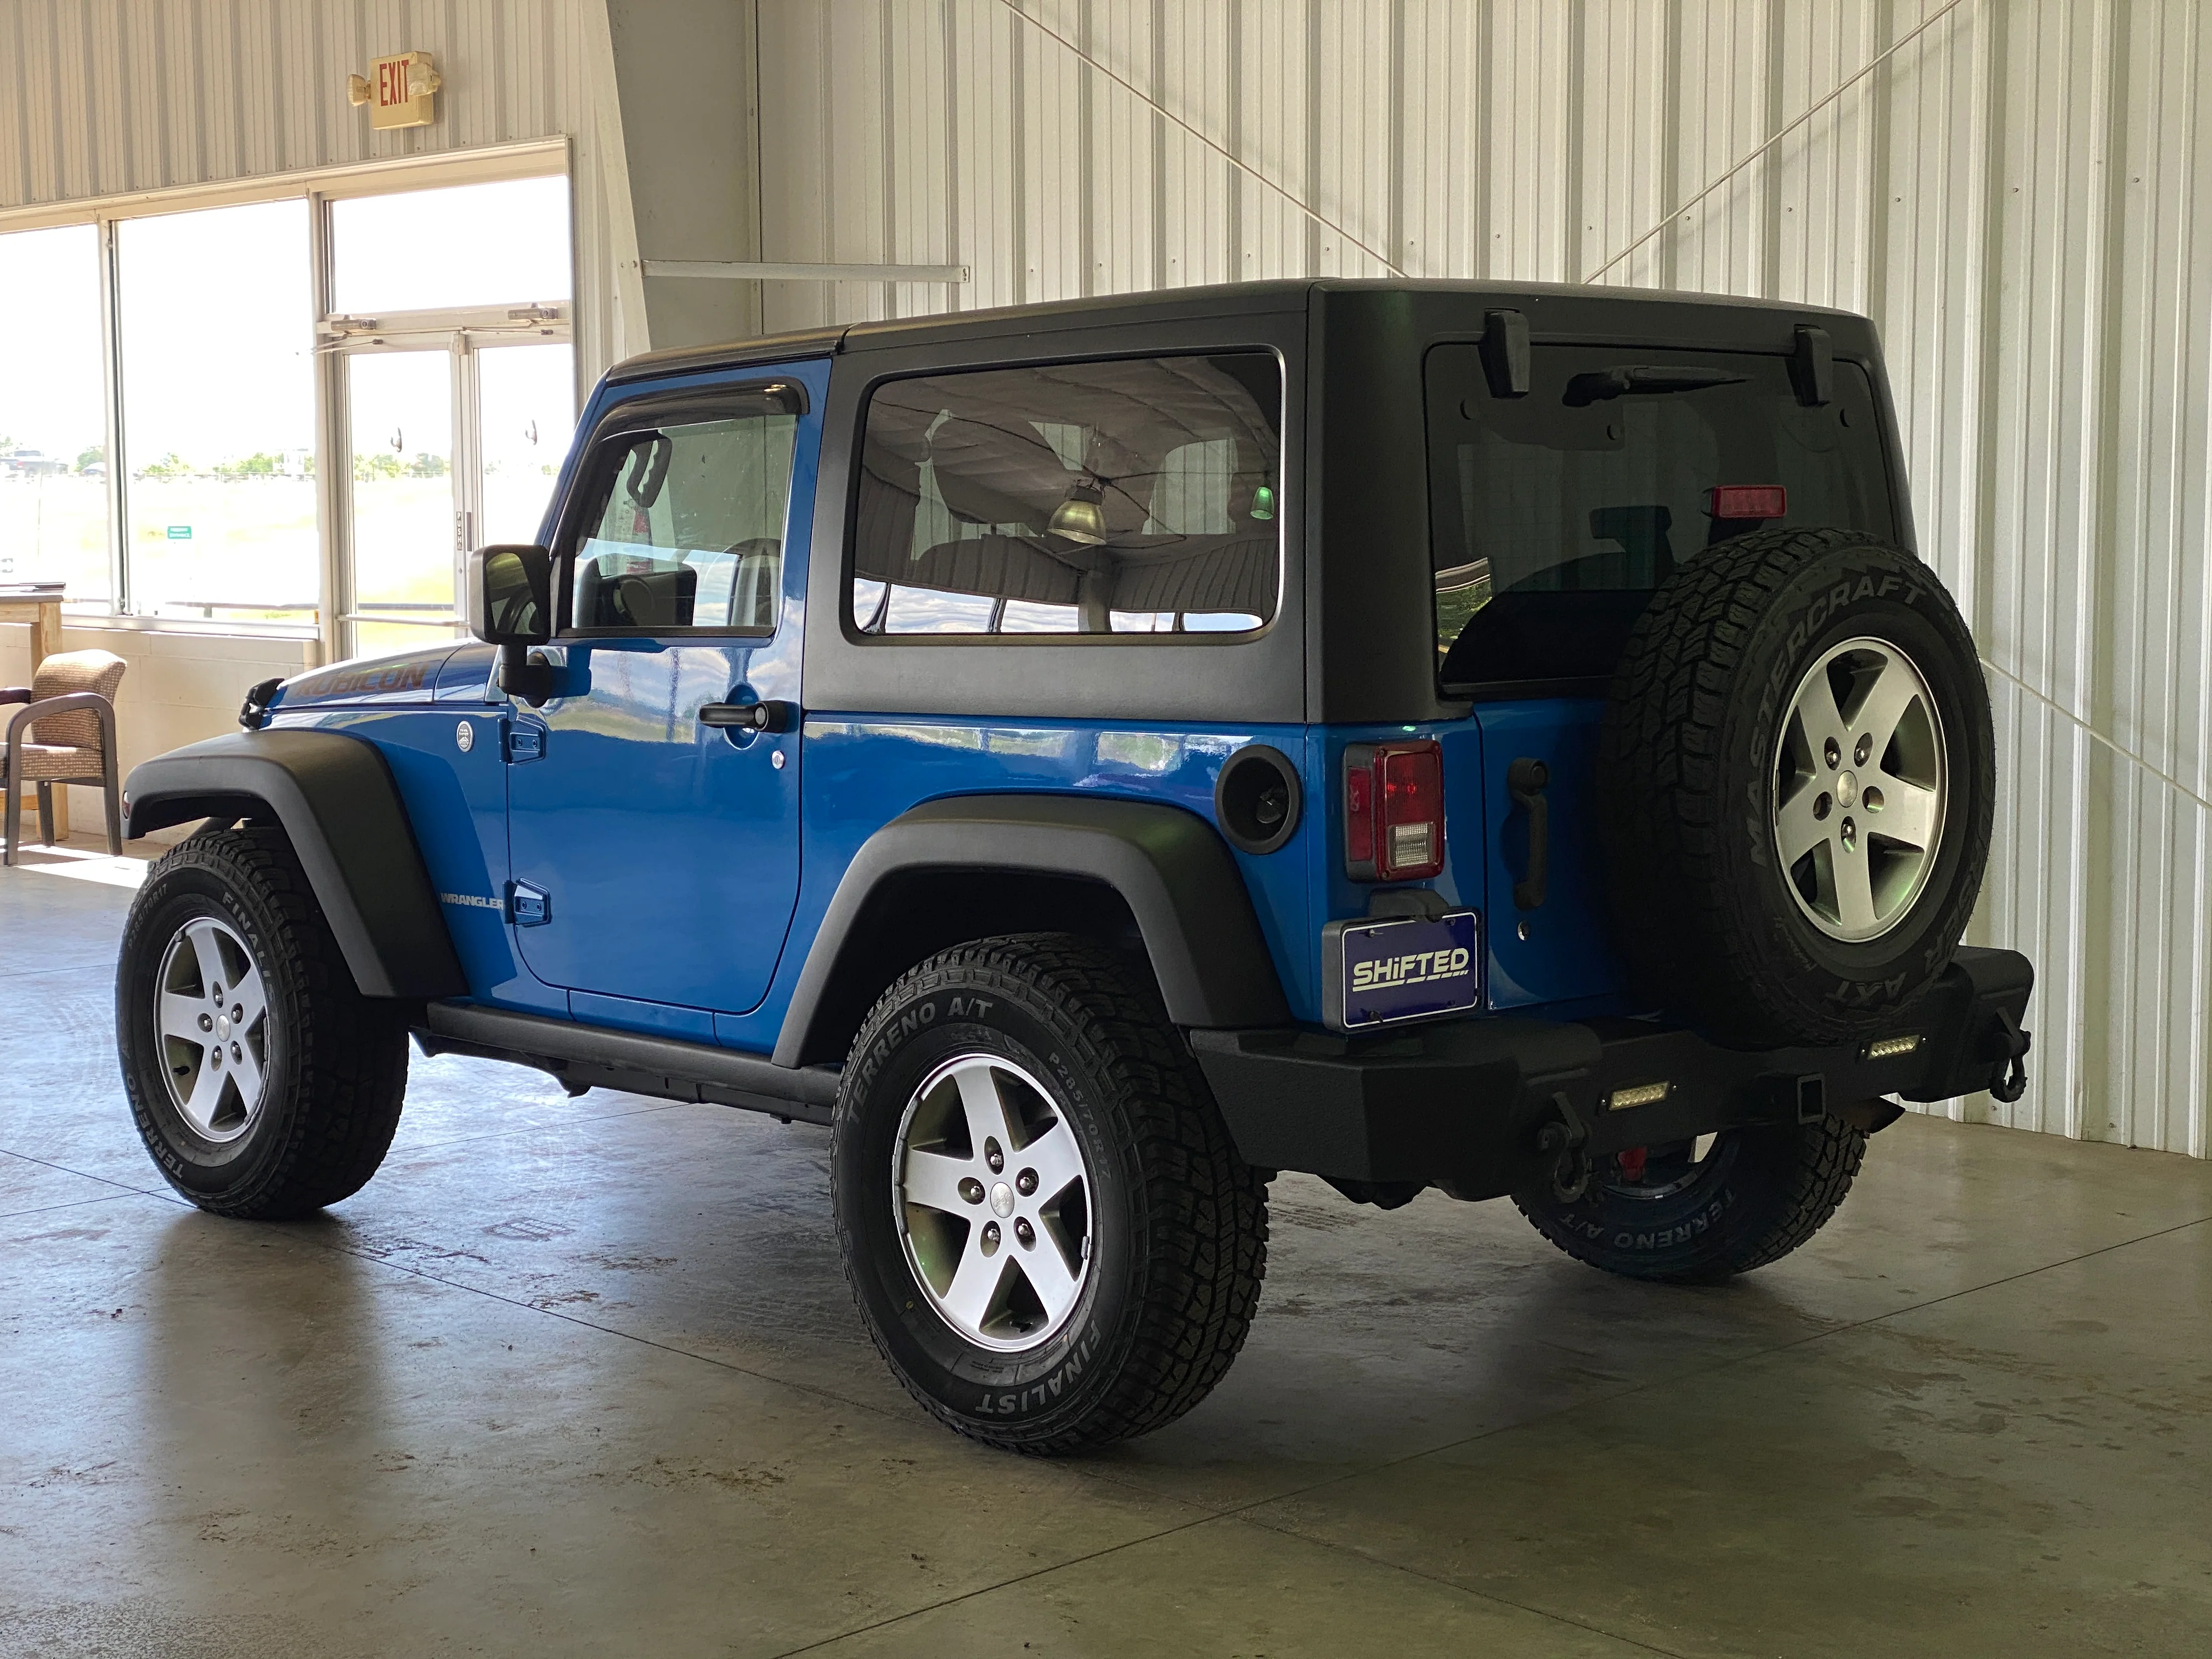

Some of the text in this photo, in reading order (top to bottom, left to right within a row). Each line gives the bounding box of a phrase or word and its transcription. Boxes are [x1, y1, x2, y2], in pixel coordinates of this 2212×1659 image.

[379, 59, 409, 106] EXIT
[296, 663, 428, 697] RUBICON
[1745, 574, 1927, 867] MASTERCRAFT
[441, 893, 504, 910] WRANGLER
[846, 996, 993, 1126] TERRENO A/T
[127, 1073, 183, 1179] TERRENO
[993, 1192, 1011, 1210] Jeep
[1613, 1187, 1736, 1249] TERRENO
[975, 1320, 1102, 1415] FINALIST
